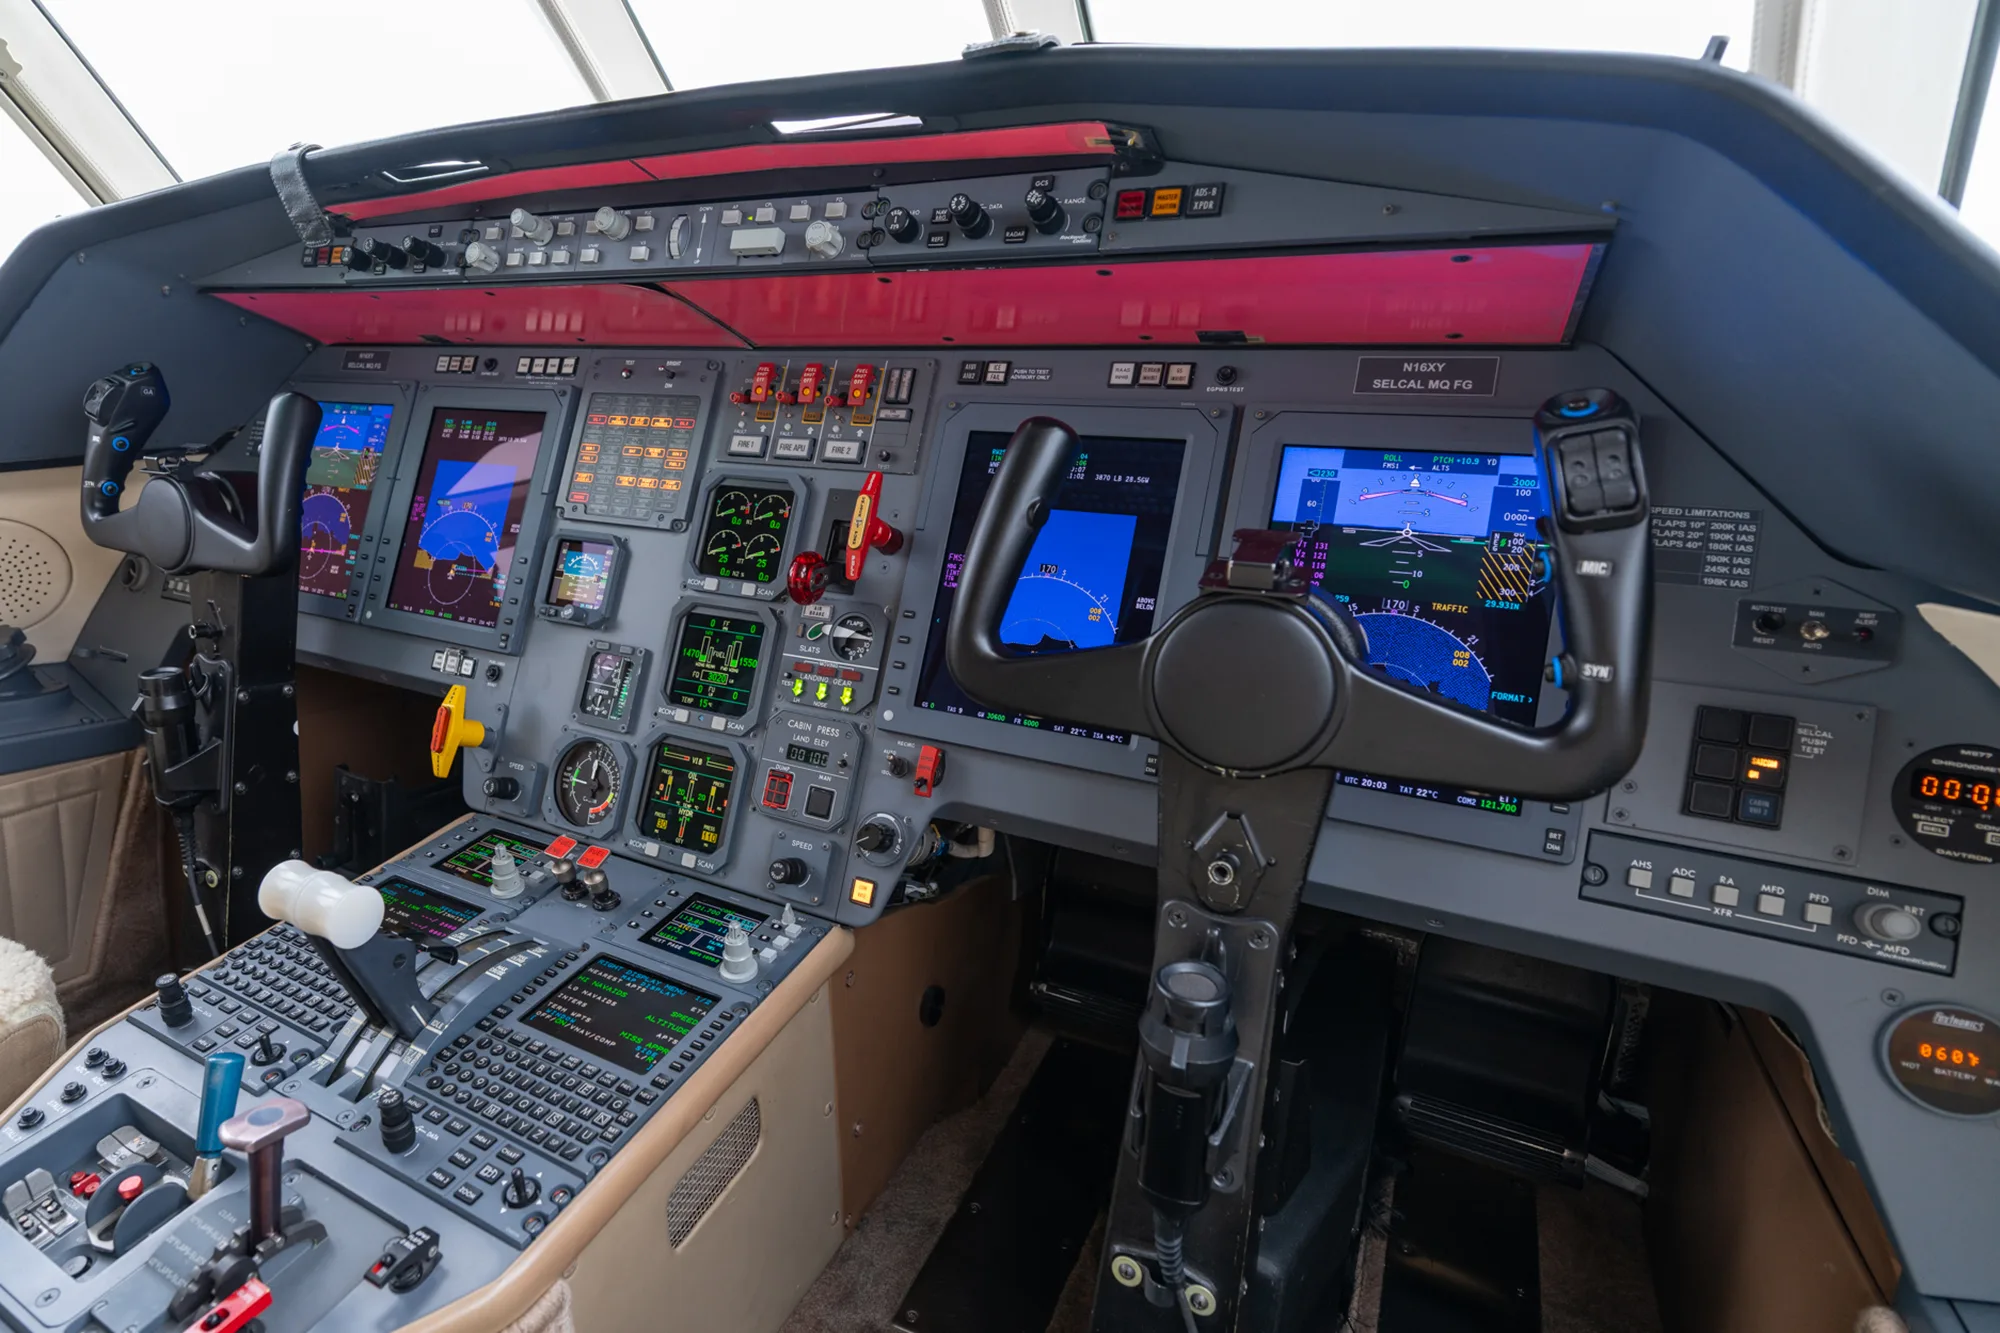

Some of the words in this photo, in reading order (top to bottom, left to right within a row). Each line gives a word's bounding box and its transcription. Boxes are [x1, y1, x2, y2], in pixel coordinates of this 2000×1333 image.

[1195, 188, 1217, 197] ADS-B
[1193, 201, 1214, 210] XPDR
[1403, 363, 1446, 372] N16XY
[1373, 379, 1425, 389] SELCAL
[1428, 380, 1450, 390] MQ
[1454, 380, 1473, 390] FG
[1384, 454, 1403, 462] ROLL
[1487, 458, 1497, 466] YD
[1432, 464, 1450, 472] ALTS
[1096, 474, 1111, 482] 3870
[1512, 477, 1535, 487] 3000
[1515, 489, 1531, 497] 100
[1685, 508, 1750, 520] LIMITATIONS
[1653, 519, 1687, 529] FLAPS
[1710, 522, 1735, 531] 200K
[1739, 524, 1756, 532] IAS
[1709, 532, 1735, 541] 190K
[1737, 534, 1755, 542] IAS
[719, 555, 728, 563] 25
[757, 559, 767, 568] 25
[1706, 555, 1730, 564] 190K
[1042, 565, 1057, 573] 170
[1582, 561, 1607, 575] MIC
[1704, 565, 1730, 574] 245K
[1732, 567, 1750, 575] IAS
[1730, 579, 1748, 588] IAS
[1137, 597, 1155, 605] ABOVE
[1386, 601, 1405, 610] 170
[1485, 600, 1520, 610] 29.93IN
[1136, 603, 1154, 611] BELOW
[1432, 602, 1468, 614] TRAFFIC
[683, 648, 700, 658] 1470
[800, 645, 821, 654] SLATS
[1454, 650, 1470, 659] 008
[739, 658, 758, 669] 1550
[1453, 659, 1469, 667] 002
[1582, 663, 1609, 678] SYN
[801, 674, 828, 683] LANDING
[833, 679, 852, 687] GEAR
[1491, 692, 1525, 703] FORMAT
[987, 713, 1006, 722] 30600
[728, 722, 744, 730] SCAN
[788, 720, 811, 731] CABIN
[817, 726, 840, 737] PRESS
[1023, 719, 1039, 728] 6000
[1070, 727, 1087, 737] 22°C
[1797, 728, 1834, 739] SELCAL
[793, 734, 810, 743] LAND
[814, 738, 830, 747] ELEV
[1801, 737, 1827, 746] PUSH
[1801, 745, 1825, 755] TEST
[1345, 776, 1359, 785] UTC
[1362, 779, 1387, 790] 20:03
[1400, 786, 1413, 795] TAT
[1416, 788, 1438, 799] 22°C
[1457, 796, 1477, 806] COM2
[1481, 800, 1517, 813] 121.700
[1913, 813, 1955, 825] SELECT
[1549, 832, 1562, 840] BRT
[792, 840, 813, 851] SPEED
[1547, 843, 1560, 851] DIM
[1936, 848, 1993, 863] DAVTRON
[697, 860, 714, 870] SCAN
[1631, 859, 1652, 869] AHS
[1672, 868, 1696, 878] ADC
[1720, 876, 1734, 885] RA
[1761, 884, 1785, 895] MFD
[1868, 887, 1890, 898] DIM
[1809, 892, 1830, 903] PFD
[1713, 908, 1733, 918] XFR
[651, 937, 665, 945] NEXT
[667, 942, 683, 950] PAGE
[1837, 934, 1857, 945] PFD
[1883, 945, 1910, 956] MFD
[588, 967, 623, 984] NEAREST
[626, 982, 647, 993] APTS
[599, 959, 622, 972] RIGHT
[625, 967, 661, 987] DISPLAY
[666, 983, 687, 996] MENU
[592, 980, 629, 998] NAVAIDS
[621, 975, 637, 984] MAP
[640, 982, 676, 998] DISPLAY
[558, 993, 588, 1008] INTERS
[582, 989, 618, 1007] NAVAIDS
[545, 1008, 577, 1024] WINDOW
[547, 1001, 568, 1013] TERM
[571, 1012, 592, 1023] WPTS
[690, 1006, 707, 1016] ETA
[670, 1011, 699, 1026] SPEED
[431, 1020, 444, 1029] IDLE
[645, 1014, 690, 1036] ALTITUDE
[620, 1031, 643, 1044] MISS
[646, 1042, 670, 1055] APPR
[656, 1033, 679, 1045] APTS
[635, 1045, 658, 1058] SIDE
[1901, 1061, 1920, 1070] HOT
[1934, 1067, 1977, 1081] BATTERY
[656, 1076, 669, 1085] EXEC
[640, 1091, 654, 1100] NEXT
[426, 1131, 439, 1140] DATA
[502, 1148, 520, 1160] CHART
[459, 1188, 476, 1200] ZOOM
